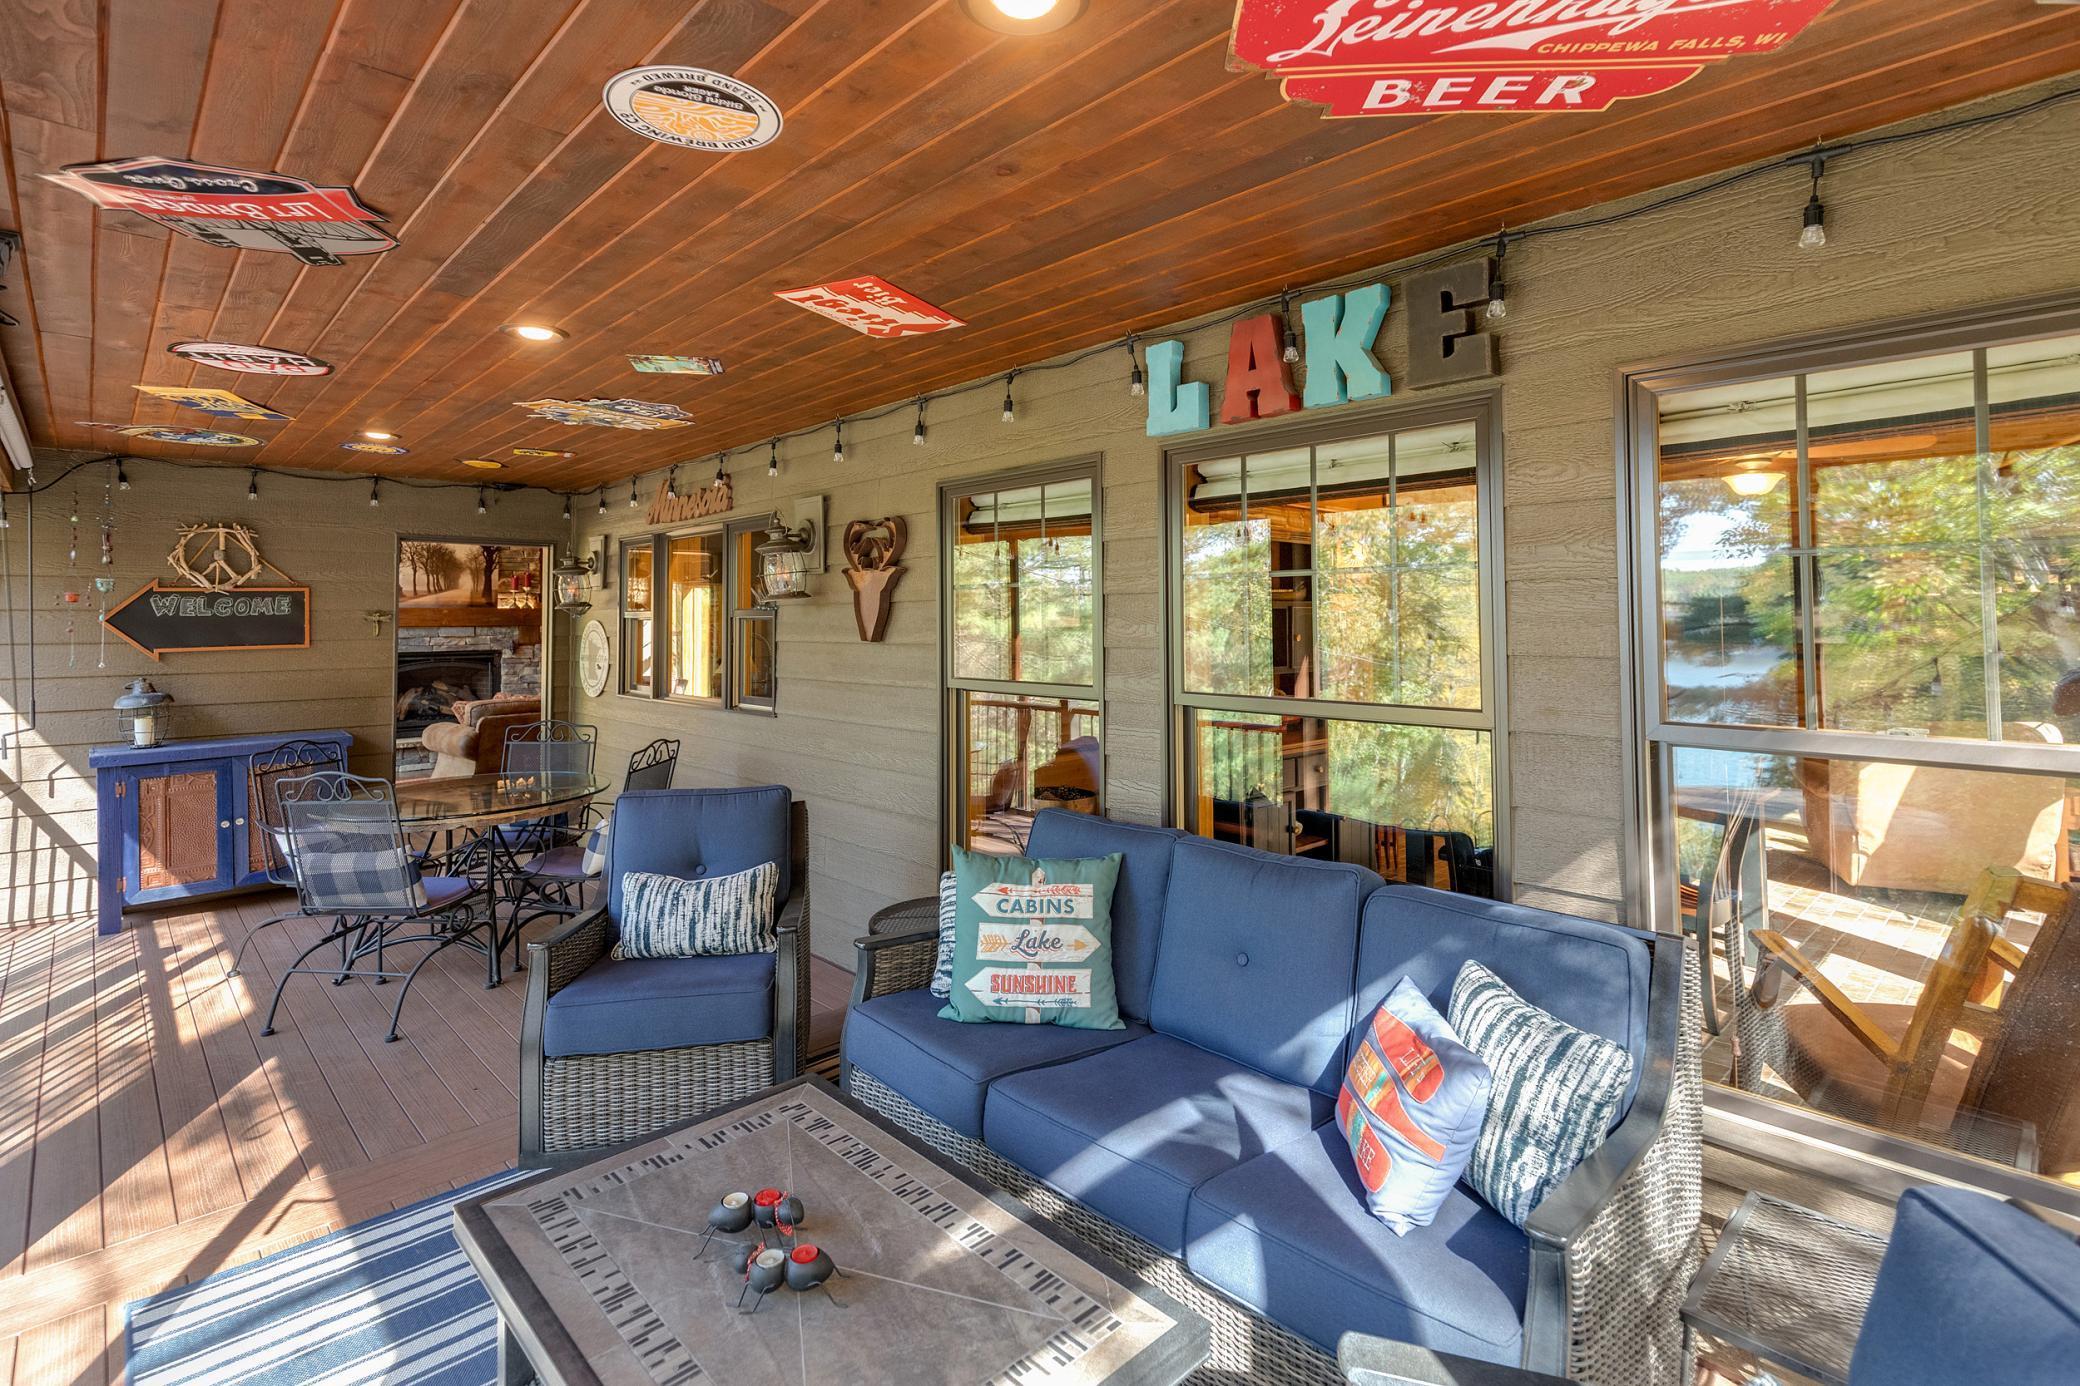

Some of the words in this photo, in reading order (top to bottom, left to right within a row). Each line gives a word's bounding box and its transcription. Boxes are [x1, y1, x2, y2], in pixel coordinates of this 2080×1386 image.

[1537, 40, 1660, 54] CHIPPEWA
[1668, 34, 1745, 50] FALLS,
[1755, 32, 1788, 46] WI
[643, 72, 706, 82] BREWED
[713, 79, 761, 104] ISLAND
[1362, 73, 1597, 109] BEER
[637, 124, 717, 149] BREWING
[720, 136, 760, 149] MAUI
[1145, 256, 1502, 438] LAKE
[189, 351, 316, 367] HABIT
[222, 360, 307, 373] BAD
[646, 473, 733, 525] Minnesota
[150, 593, 292, 617] WELCOME
[996, 897, 1075, 914] CABINS
[1010, 928, 1064, 958] Lake
[990, 973, 1077, 994] SUNSHINE
